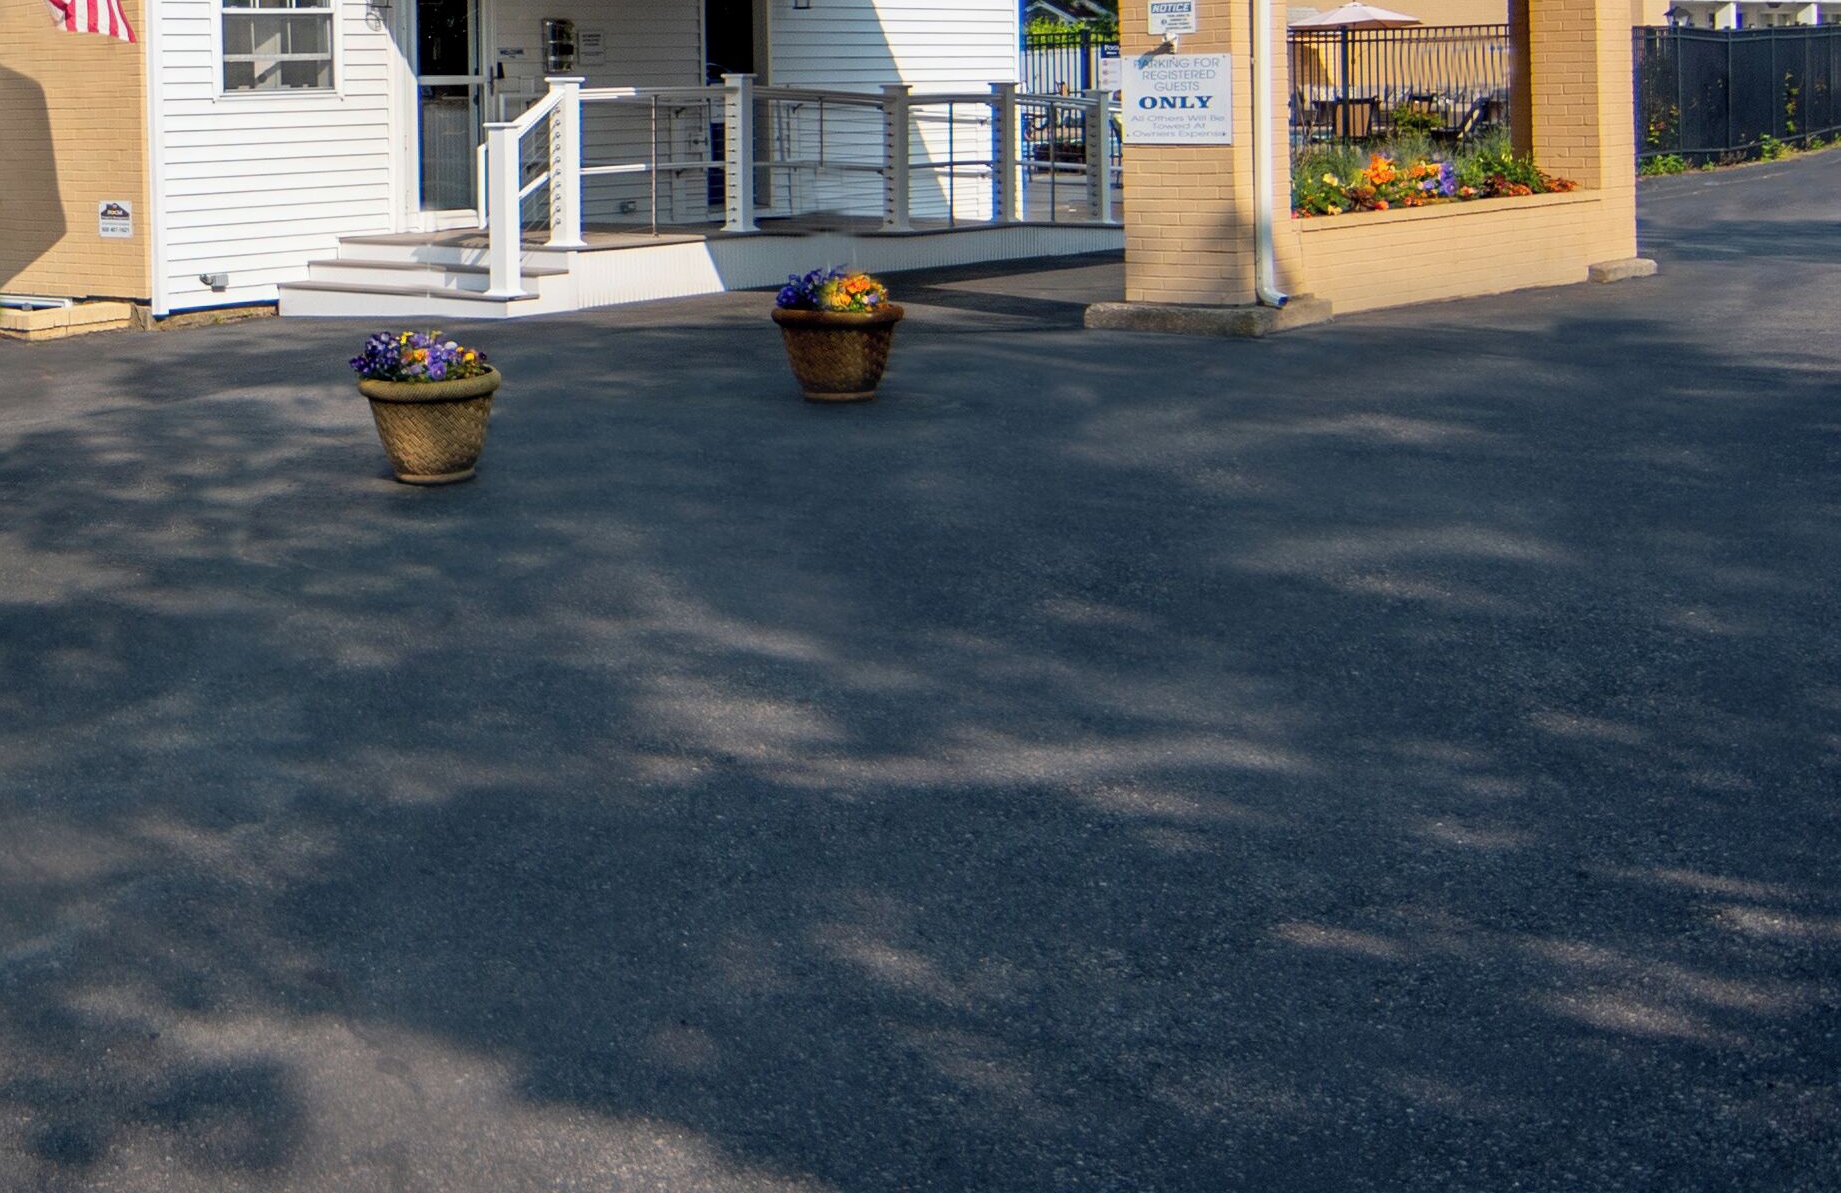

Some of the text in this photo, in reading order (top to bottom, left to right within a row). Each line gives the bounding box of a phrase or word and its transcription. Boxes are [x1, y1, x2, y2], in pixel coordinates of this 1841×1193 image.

[1152, 3, 1190, 13] NOTICE
[1134, 58, 1220, 69] PARKING FOR
[1142, 69, 1217, 81] REGISTERED
[1154, 81, 1200, 92] GUESTS
[1138, 95, 1212, 110] ONLY
